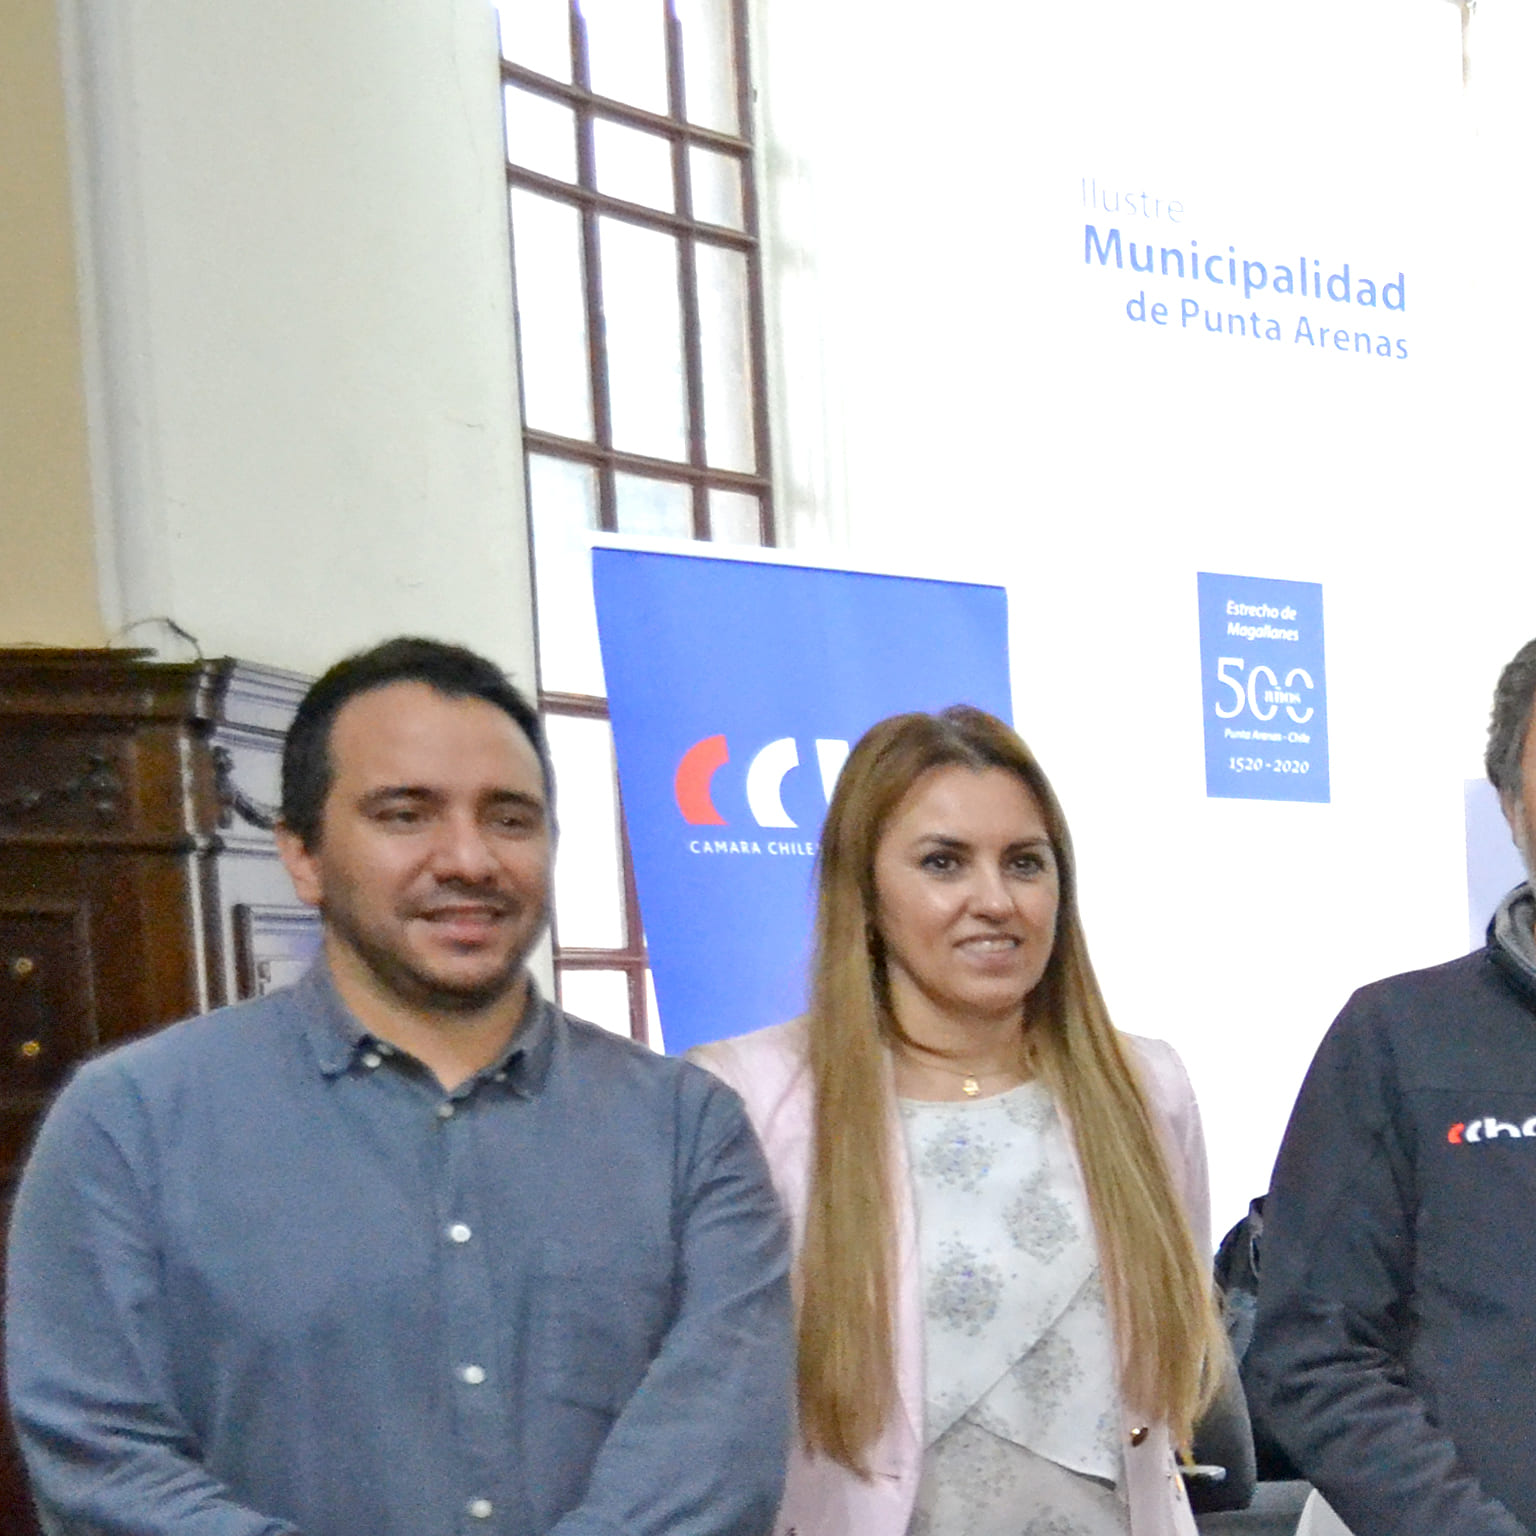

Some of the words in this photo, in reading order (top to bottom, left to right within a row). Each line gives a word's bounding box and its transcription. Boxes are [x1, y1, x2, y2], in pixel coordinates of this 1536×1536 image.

[1081, 177, 1185, 223] Ilustre
[1084, 224, 1406, 312] Municipalidad
[1125, 290, 1169, 325] de
[1180, 297, 1281, 341] Punta
[1294, 315, 1408, 360] Arenas
[1226, 599, 1279, 619] Estrecho
[1280, 605, 1297, 621] de
[1227, 621, 1299, 642] Magallanes
[1228, 757, 1263, 773] 1520
[1272, 759, 1310, 774] 2020
[690, 840, 761, 854] CAMARA
[767, 841, 820, 856] CHILE
